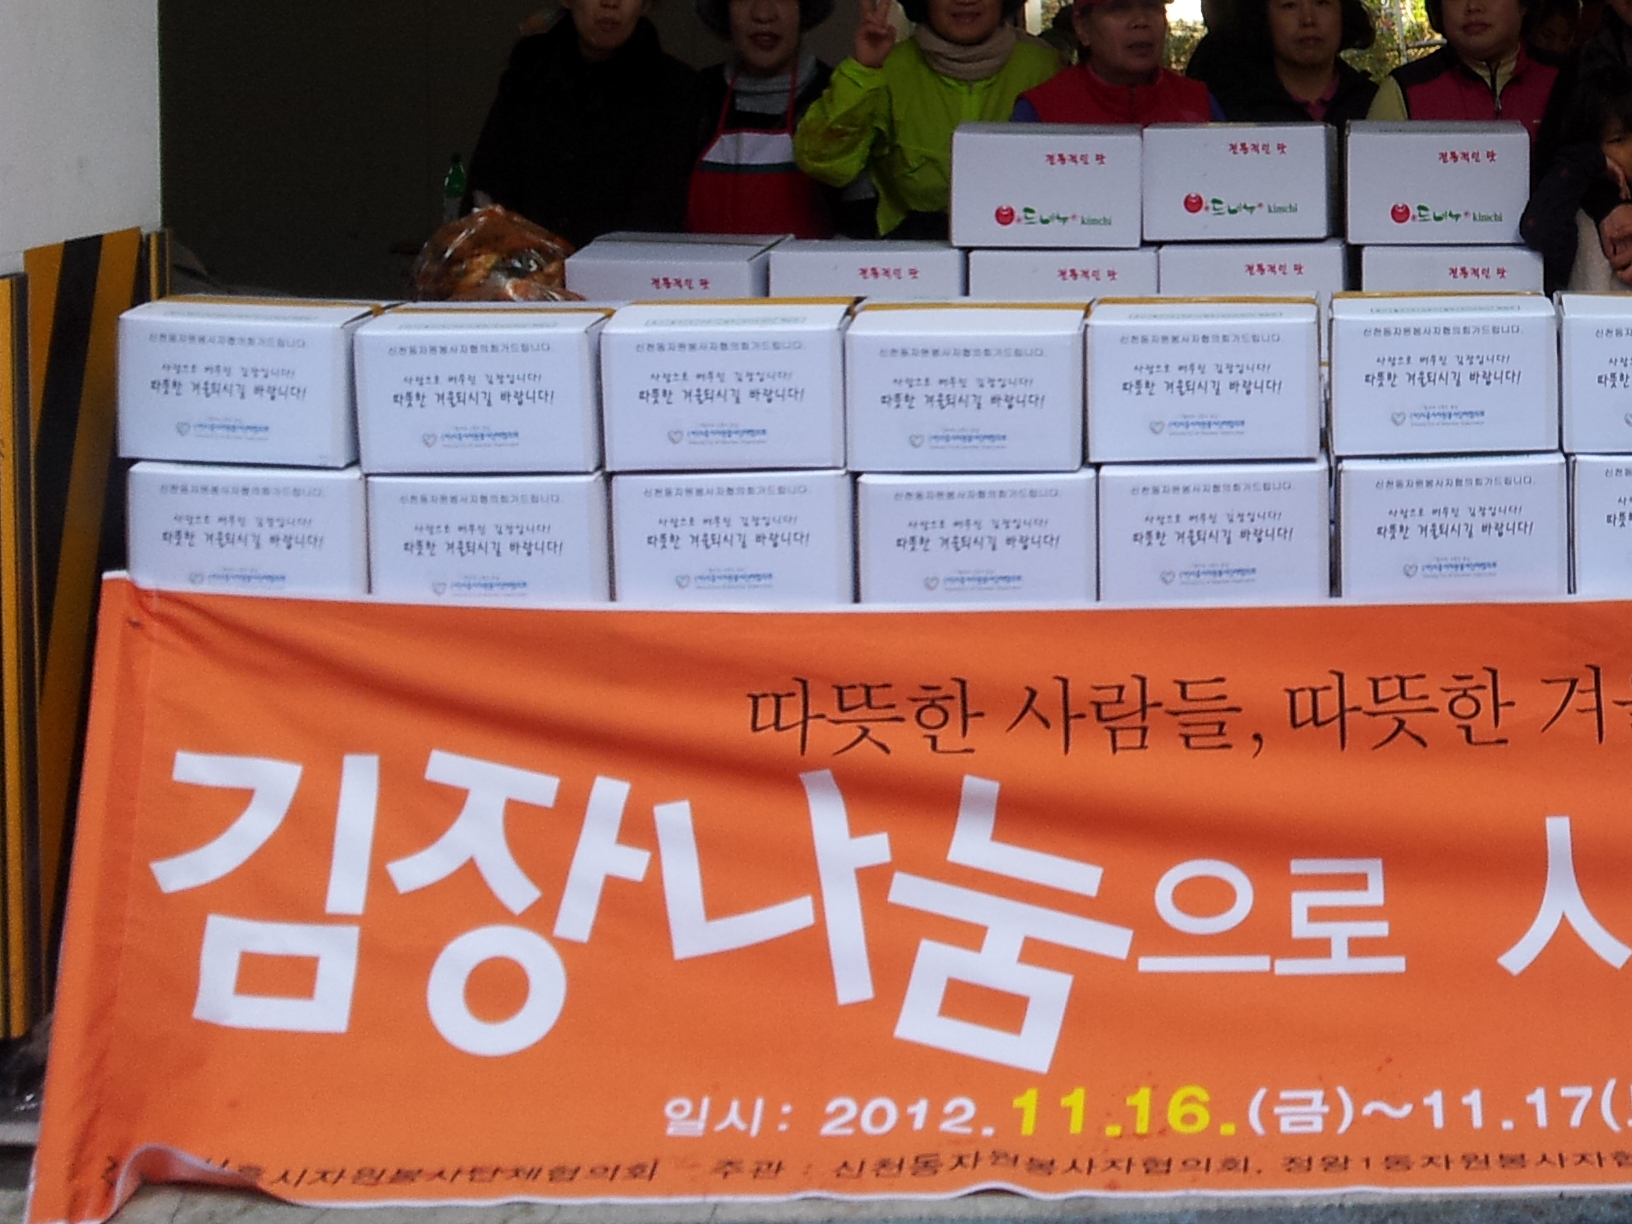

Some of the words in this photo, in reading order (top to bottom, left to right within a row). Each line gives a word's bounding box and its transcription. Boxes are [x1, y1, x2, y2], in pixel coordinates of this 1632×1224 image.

[747, 678, 984, 756] 따뜻한
[1004, 674, 1262, 758] 사람들,
[1284, 666, 1517, 753] 따뜻한
[149, 750, 1407, 1074] 김장나눔으로
[663, 1096, 793, 1138] 일시:
